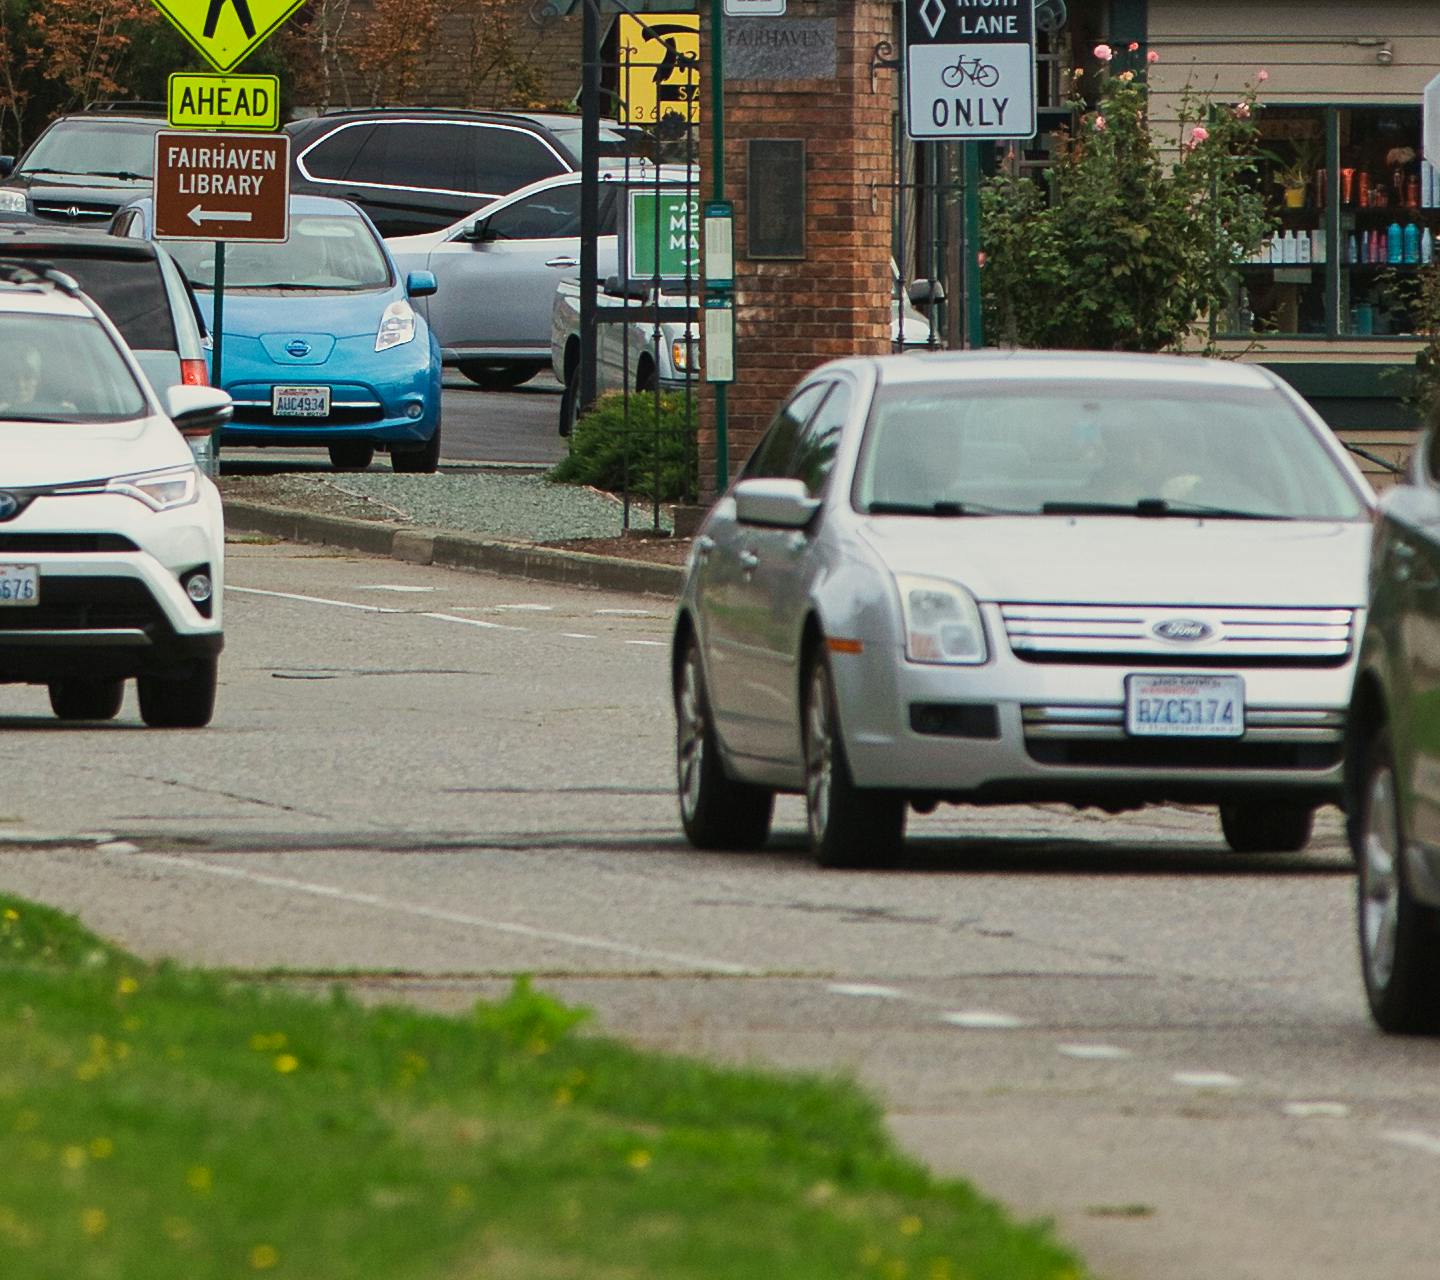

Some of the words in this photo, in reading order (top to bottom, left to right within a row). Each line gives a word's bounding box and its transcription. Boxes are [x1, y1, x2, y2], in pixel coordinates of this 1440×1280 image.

[961, 15, 1019, 34] LANE
[179, 86, 269, 117] AHEAD
[932, 97, 1009, 127] ONLY
[168, 146, 276, 170] FAIRHAVEN
[178, 173, 264, 196] LIBRARY
[277, 397, 325, 411] AUC4934
